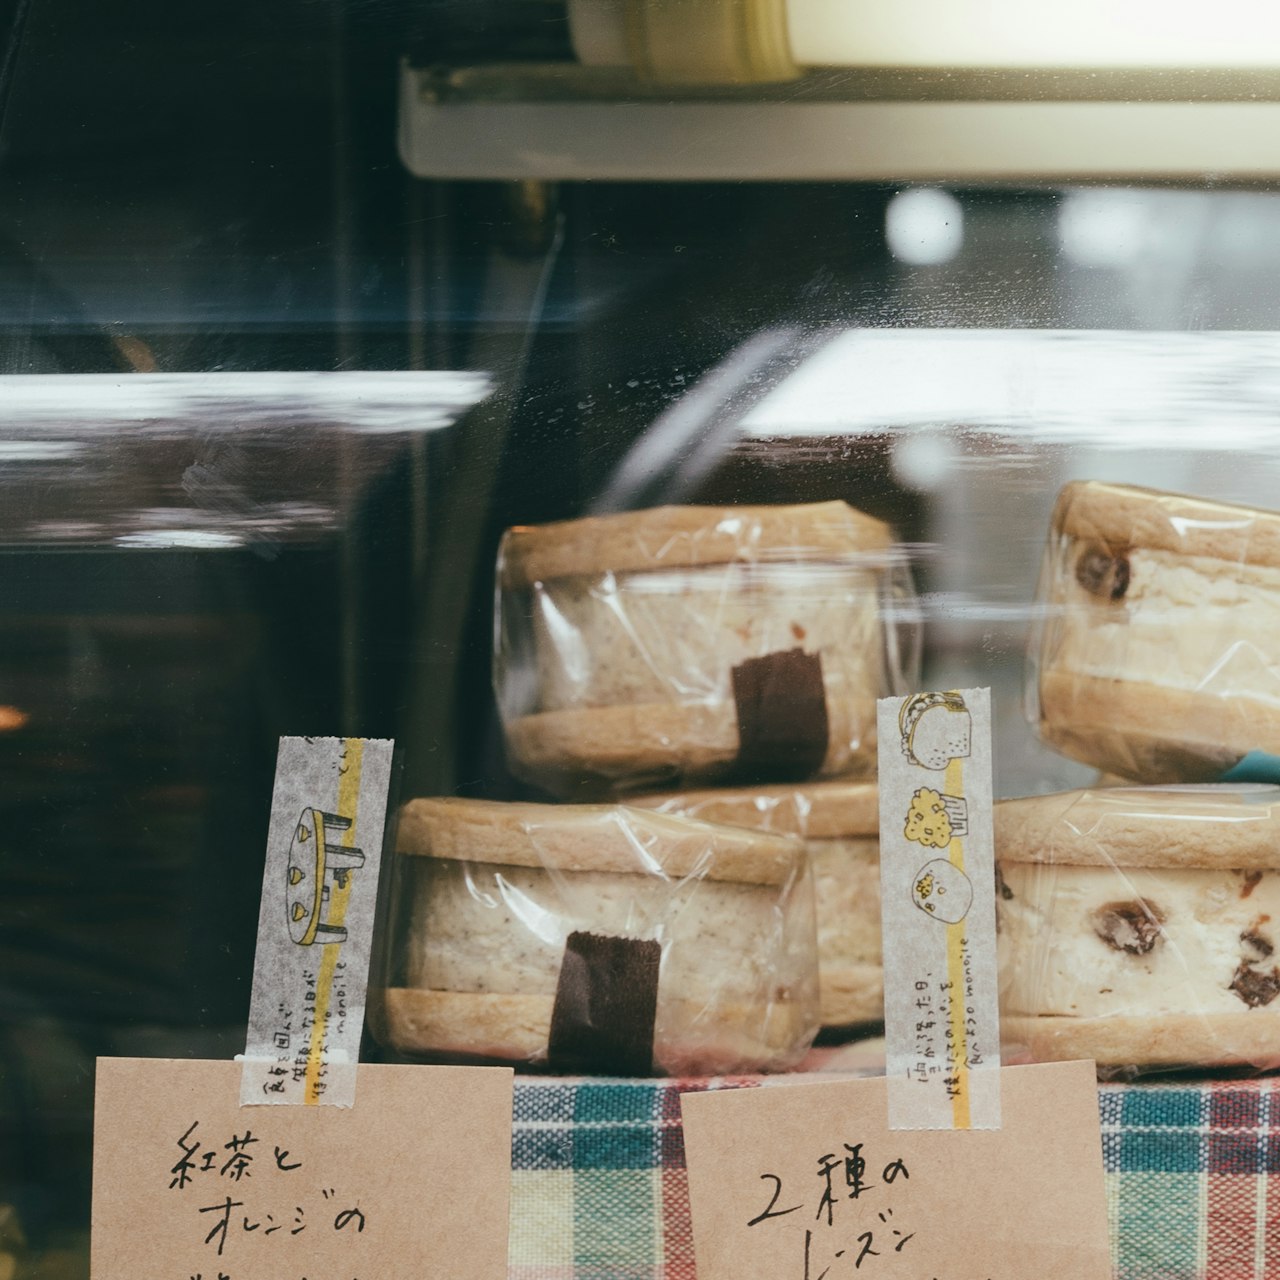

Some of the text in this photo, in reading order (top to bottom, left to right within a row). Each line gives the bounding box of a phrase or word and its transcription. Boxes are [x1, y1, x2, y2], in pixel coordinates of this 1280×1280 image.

[333, 960, 348, 1034] monoile
[263, 1003, 293, 1096] 食卓を囲んで
[939, 981, 961, 1101] 焼きたてのパンを
[168, 1121, 302, 1190] 紅茶と
[747, 1143, 909, 1226] 2種の
[199, 1187, 365, 1256] オレンジの
